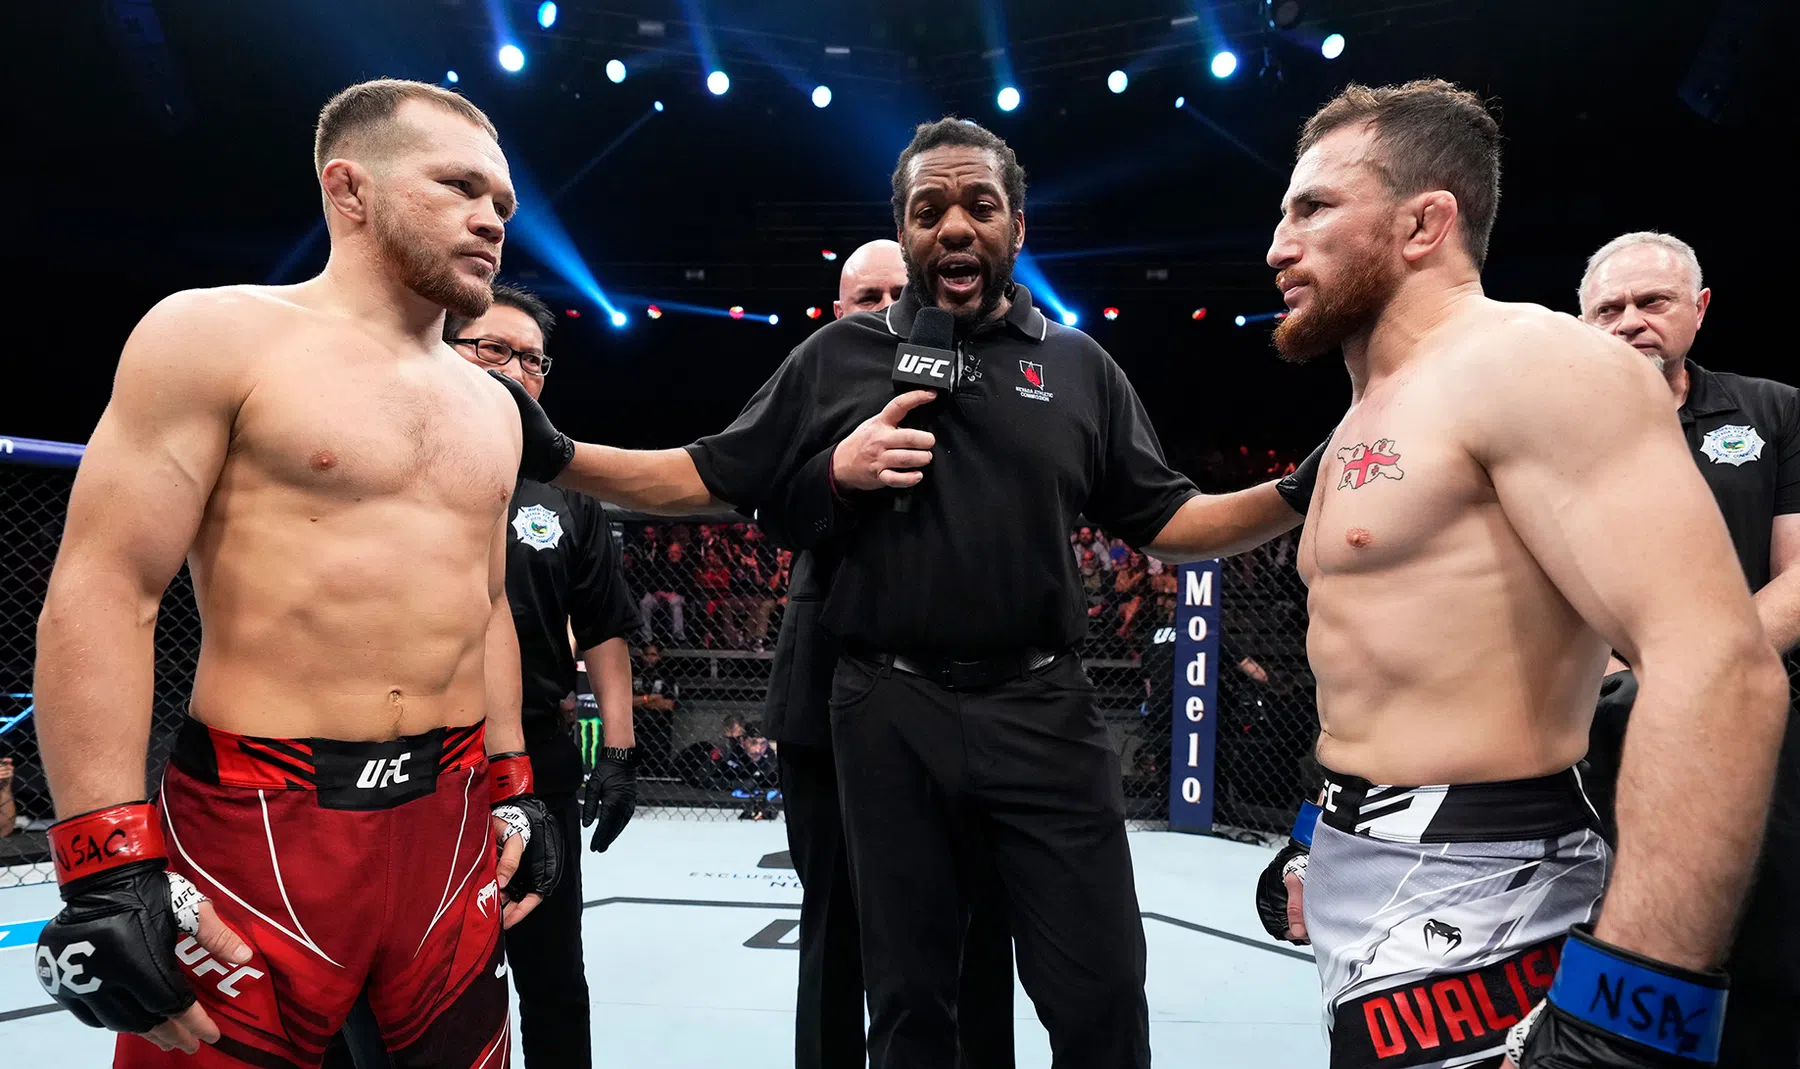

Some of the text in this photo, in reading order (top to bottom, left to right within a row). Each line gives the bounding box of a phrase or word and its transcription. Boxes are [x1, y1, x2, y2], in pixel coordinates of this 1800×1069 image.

[897, 353, 950, 379] UFC
[1181, 570, 1214, 804] Modelo
[356, 752, 411, 789] UFC
[173, 886, 195, 909] UFC
